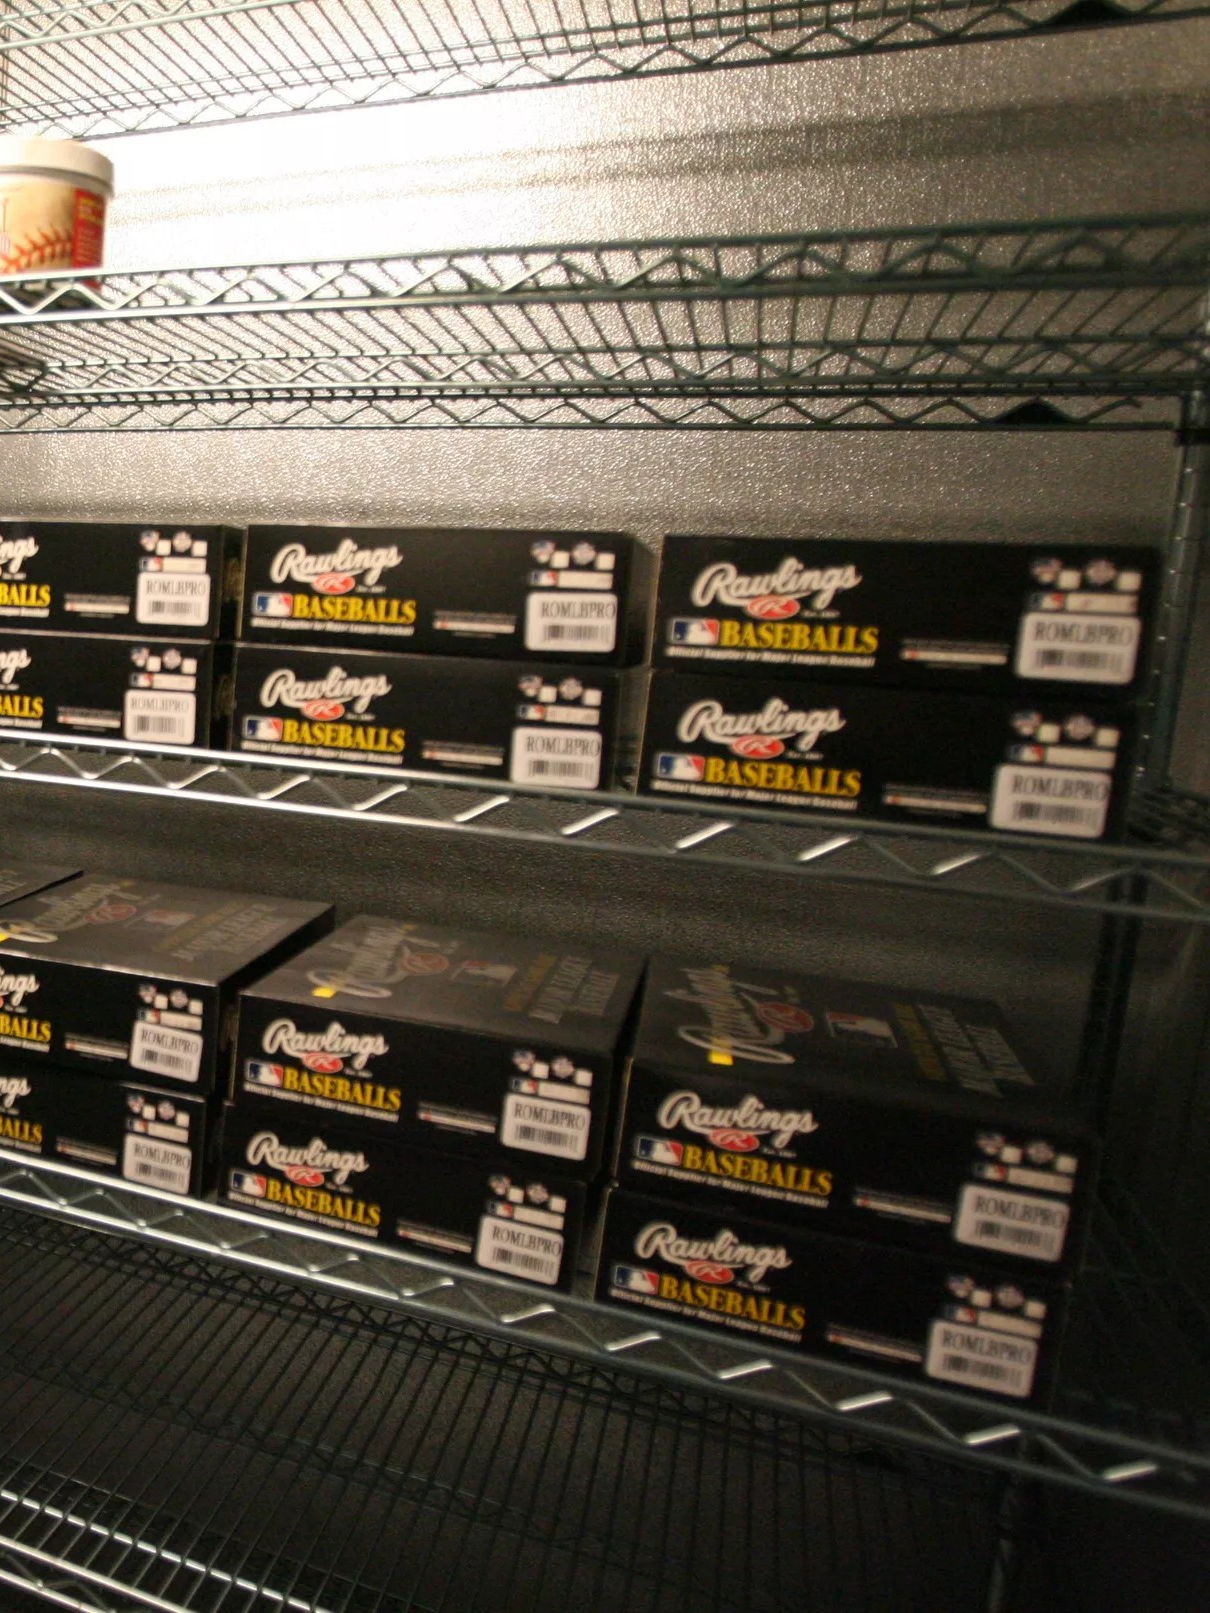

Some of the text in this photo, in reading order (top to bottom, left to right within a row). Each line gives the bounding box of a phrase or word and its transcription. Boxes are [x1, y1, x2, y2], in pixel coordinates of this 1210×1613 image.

[270, 538, 403, 586] Rawlings
[692, 556, 862, 609] Rawlings
[293, 594, 418, 625] BASEBALLS
[719, 619, 880, 654] BASEBALLS
[260, 665, 392, 713] Rawlings
[283, 719, 407, 753] BASEBALLS
[677, 698, 847, 750] Rawlings
[704, 757, 863, 797] BASEBALLS
[262, 1018, 389, 1069] Rawlings
[283, 1067, 403, 1112] BASEBALLS
[656, 1090, 819, 1149] Rawlings
[245, 1130, 369, 1184] Rawlings
[683, 1143, 834, 1199] BASEBALLS
[266, 1178, 383, 1229] BASEBALLS
[633, 1221, 793, 1282] Rawlings
[659, 1272, 806, 1333] BASEBALLS
